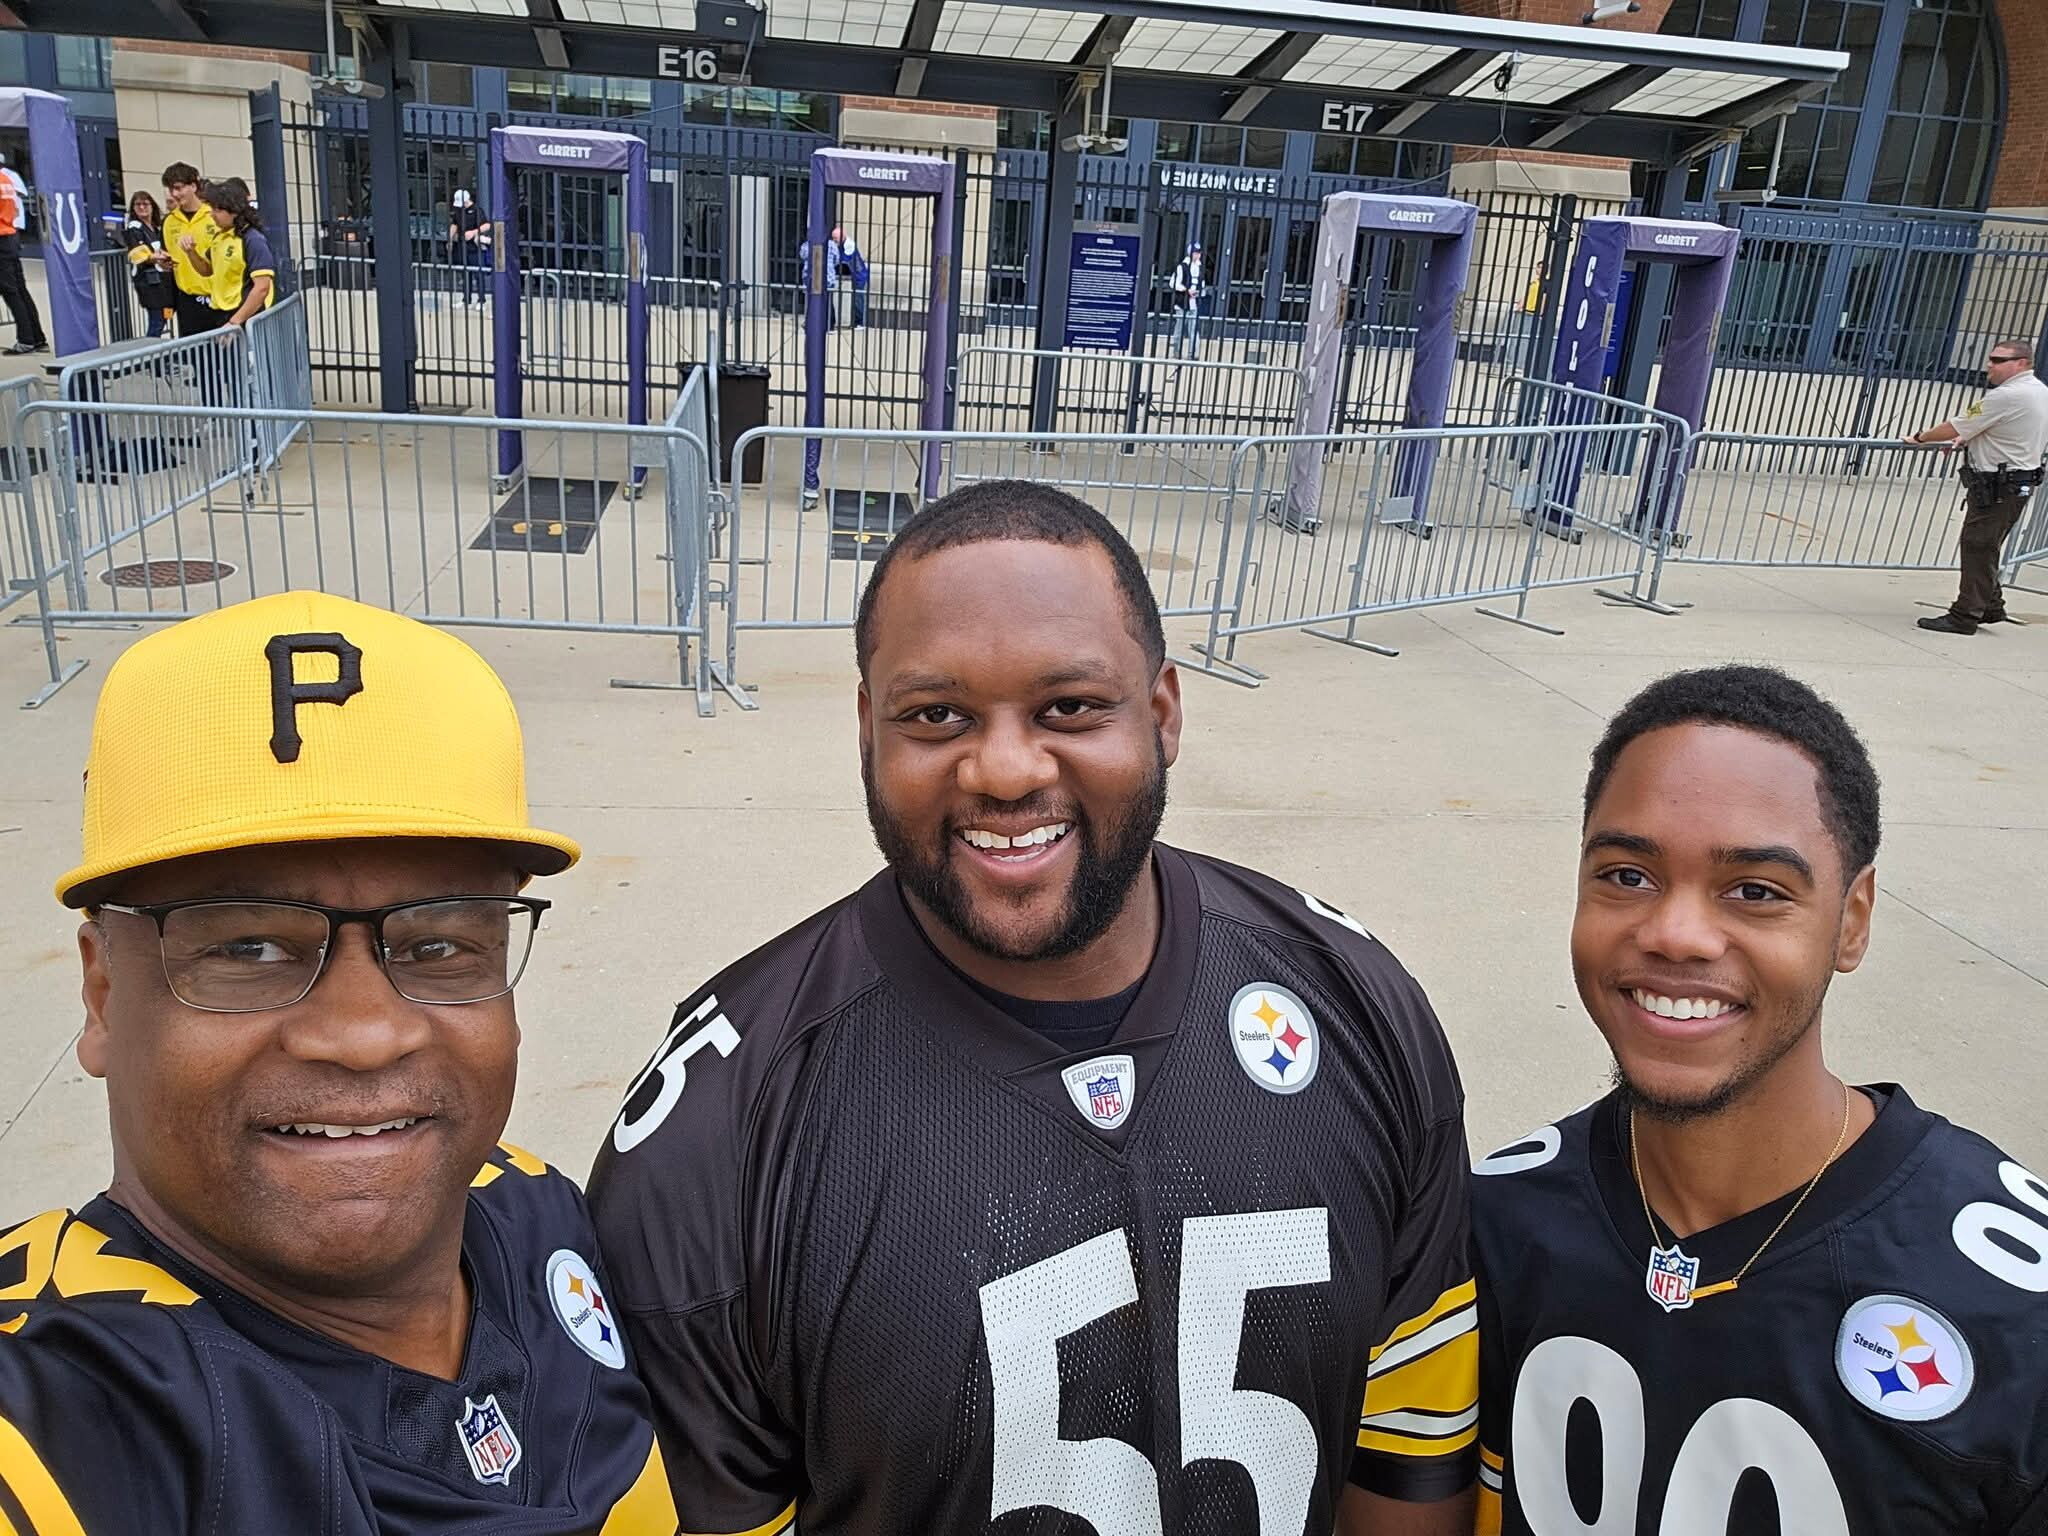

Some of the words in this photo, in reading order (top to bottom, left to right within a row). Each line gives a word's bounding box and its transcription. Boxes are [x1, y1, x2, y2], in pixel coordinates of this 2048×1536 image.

[658, 47, 717, 80] E16
[1321, 102, 1374, 133] E17
[538, 143, 593, 159] GARRETT
[858, 166, 910, 181] GARRETT
[1388, 210, 1436, 223] GARRETT
[1655, 234, 1700, 247] GARRETT
[264, 632, 364, 764] P
[1239, 1030, 1271, 1042] Steelers
[1071, 1063, 1128, 1085] EQUIPMENT
[1093, 1094, 1121, 1117] NFL
[1652, 1271, 1686, 1302] NFL
[569, 1306, 592, 1329] Steelers
[1852, 1332, 1895, 1359] Steelers
[978, 1207, 1332, 1536] 55
[474, 1430, 513, 1473] NFL
